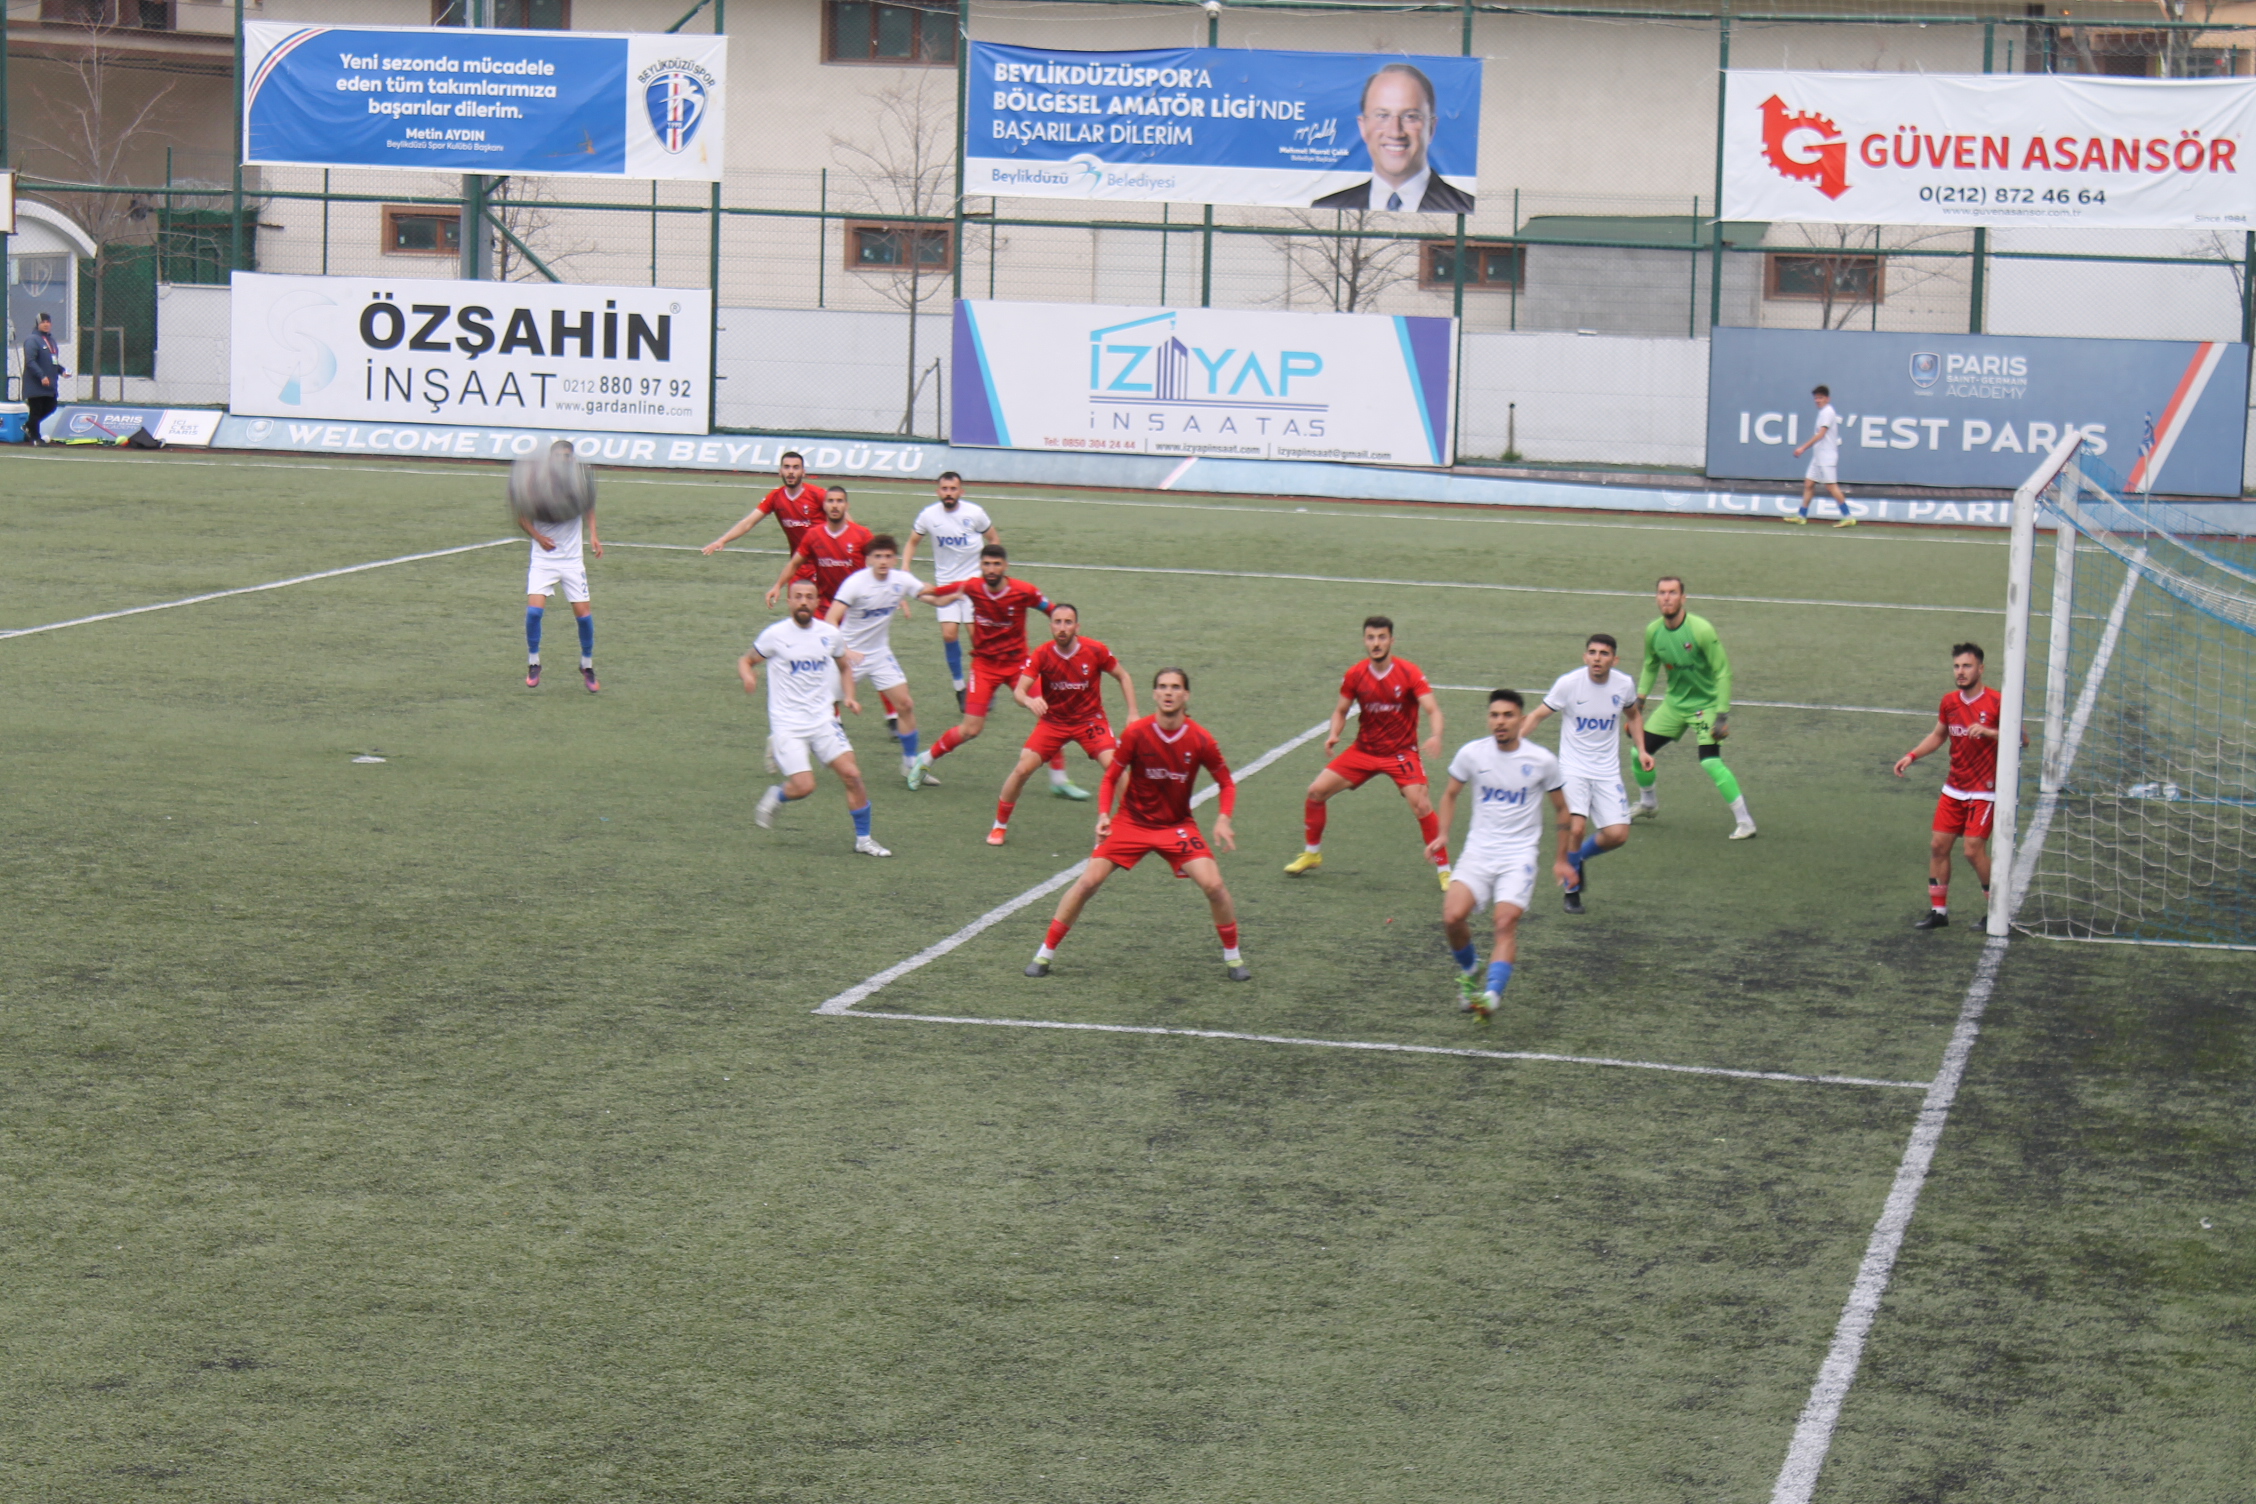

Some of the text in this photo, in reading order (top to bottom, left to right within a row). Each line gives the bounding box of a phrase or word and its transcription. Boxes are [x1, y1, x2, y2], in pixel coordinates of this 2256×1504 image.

[340, 54, 555, 76] Yeni sezonda mücadele
[637, 57, 716, 87] BEYLİKDÜZÜSPOR
[336, 76, 557, 98] eden tüm takımlarımıza
[368, 98, 523, 119] başarılar dilerim.
[993, 87, 1306, 121] BÖLGESEL AMATÖR LİGİ'NDE
[406, 128, 486, 142] Metin AYDIN
[993, 120, 1193, 145] BAŞARILAR DİLERİM
[428, 141, 446, 151] Spor
[1860, 125, 2237, 174] GÜVEN ASANSÖR
[992, 168, 1176, 191] Beylikdüzü Belediyesi
[1919, 186, 2107, 206] 0(212) 872 46 64
[359, 291, 671, 362] ÖZŞAHİN
[1946, 353, 2029, 377] PARIS
[366, 358, 557, 413] İNŞAAT
[563, 375, 691, 398] 0212 880 97 92
[1945, 384, 2027, 400] ACADEMY
[104, 414, 143, 424] PARIS
[556, 400, 693, 417] www.gardanline.com
[1739, 412, 1798, 445] ICI
[288, 424, 480, 453] WELCOME
[490, 433, 538, 455] TO
[1109, 440, 1121, 450] 24
[1123, 440, 1136, 450] 44
[1707, 492, 1761, 512] ICI
[936, 532, 968, 548] yovi
[1085, 725, 1106, 740] 25
[1575, 713, 1616, 732] yovi
[1481, 785, 1528, 804] yovi
[1175, 836, 1206, 854] 26
